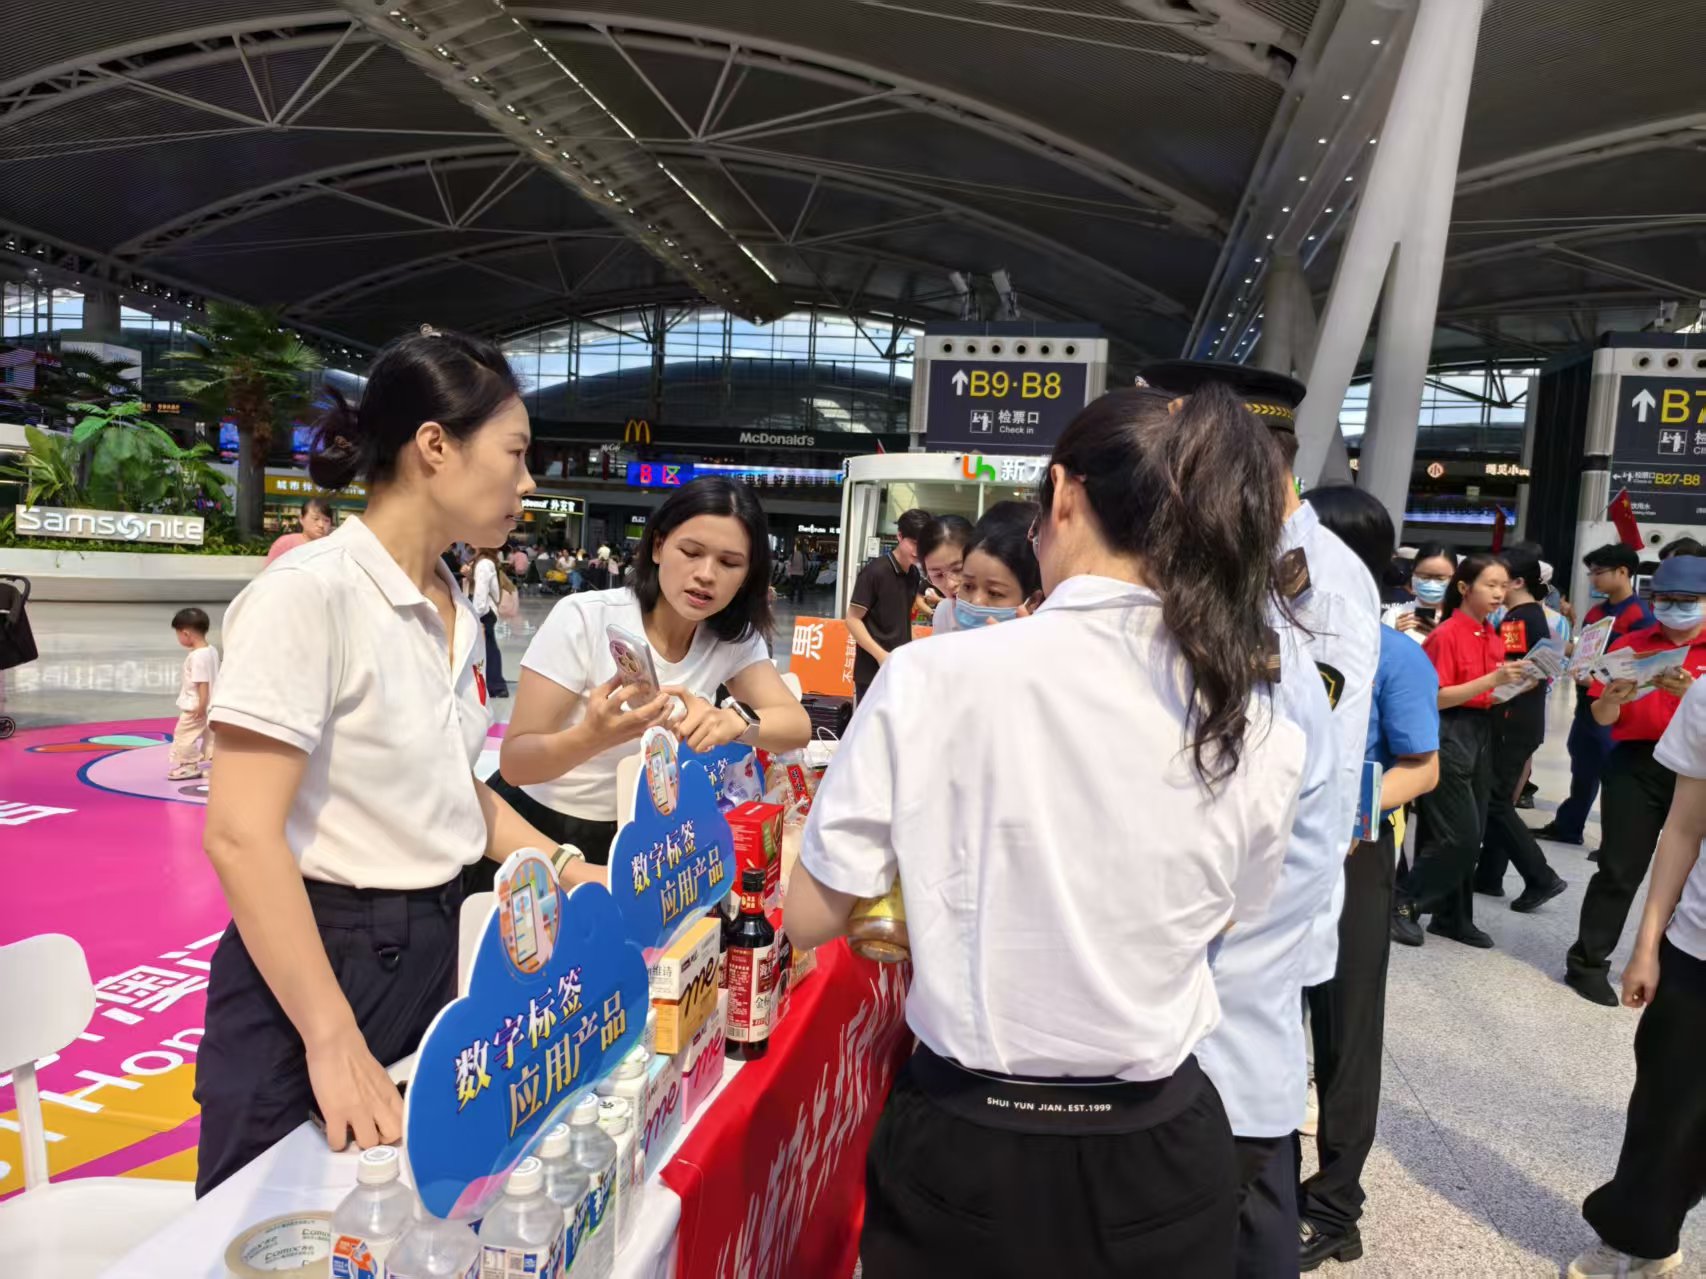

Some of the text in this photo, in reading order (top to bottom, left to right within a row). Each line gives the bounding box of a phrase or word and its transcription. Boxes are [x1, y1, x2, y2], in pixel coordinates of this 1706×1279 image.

[998, 410, 1039, 425] 检票口
[739, 432, 815, 447] McDonald's
[999, 426, 1024, 434] Check
[1655, 473, 1701, 486] B27-B8
[18, 507, 202, 541] Samsonite
[631, 820, 696, 896] 数字标签
[661, 845, 724, 927] 应用产品
[455, 967, 583, 1111] 数字标签
[509, 990, 627, 1138] 应用产品
[987, 1097, 1009, 1107] SHUI
[1014, 1102, 1034, 1110] YUN
